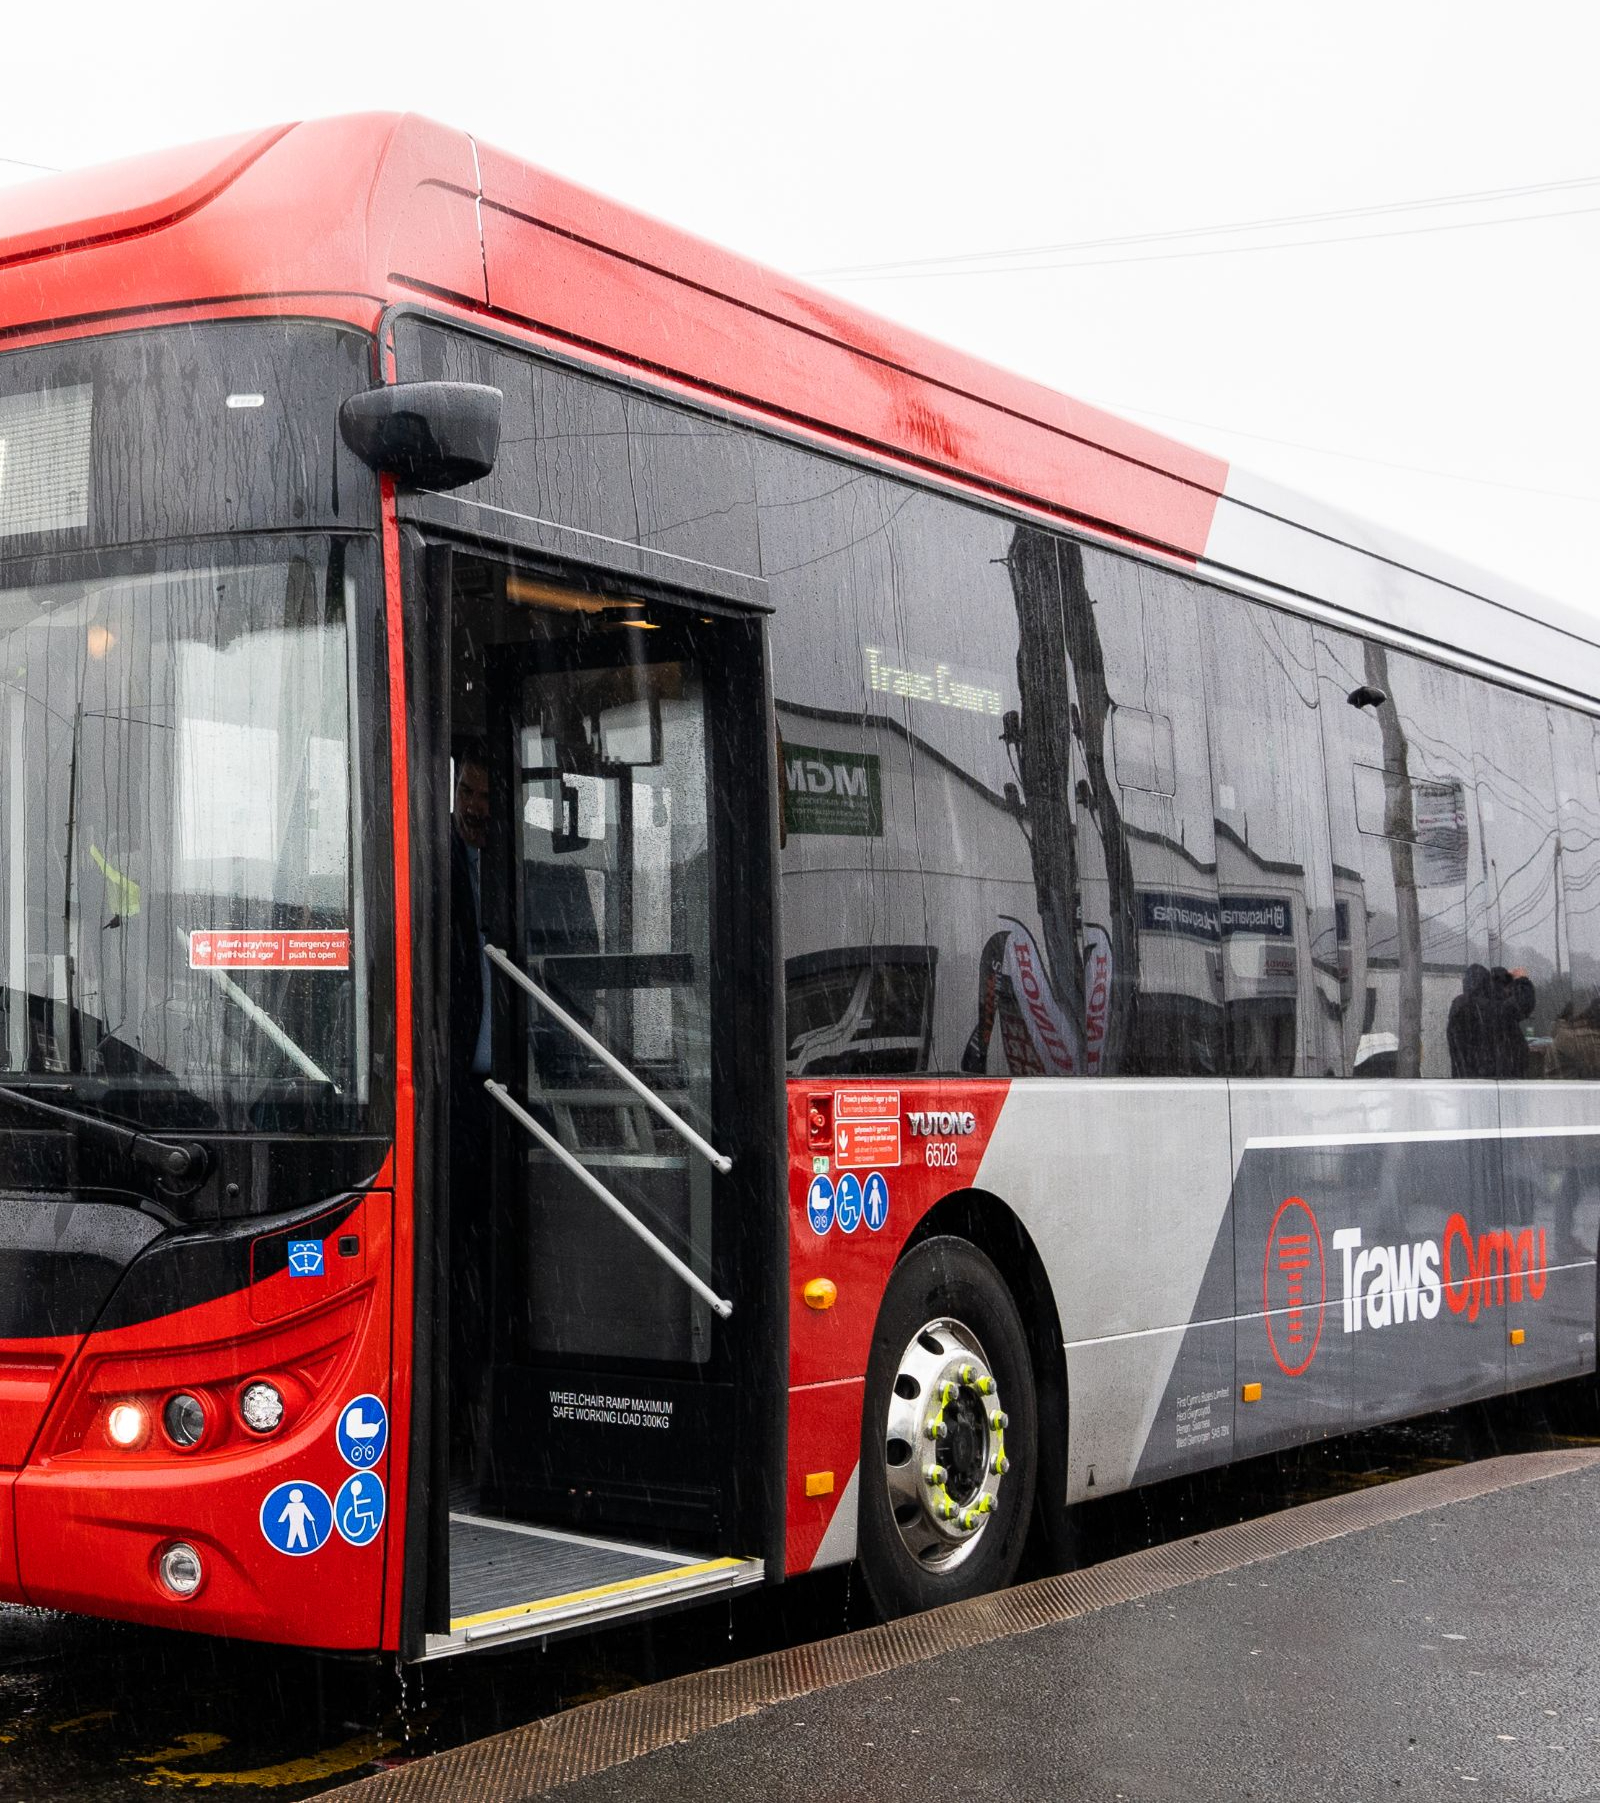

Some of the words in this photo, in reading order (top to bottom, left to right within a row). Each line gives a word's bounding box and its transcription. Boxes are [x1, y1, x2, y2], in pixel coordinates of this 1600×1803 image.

[288, 939, 331, 950] Emergency
[331, 940, 345, 948] exit
[288, 951, 308, 960] push
[317, 952, 337, 960] open
[906, 1111, 977, 1137] YUTONG
[925, 1143, 958, 1167] 65128
[1332, 1212, 1547, 1334] TrawsCymru
[549, 1391, 605, 1408] WHEELCHAIR
[605, 1396, 630, 1410] RAMP
[631, 1398, 673, 1415] MAXIMUM
[552, 1405, 575, 1420] SAFE
[575, 1408, 617, 1424] WORKING
[617, 1412, 641, 1426] LOAD
[641, 1414, 669, 1429] 300KG
